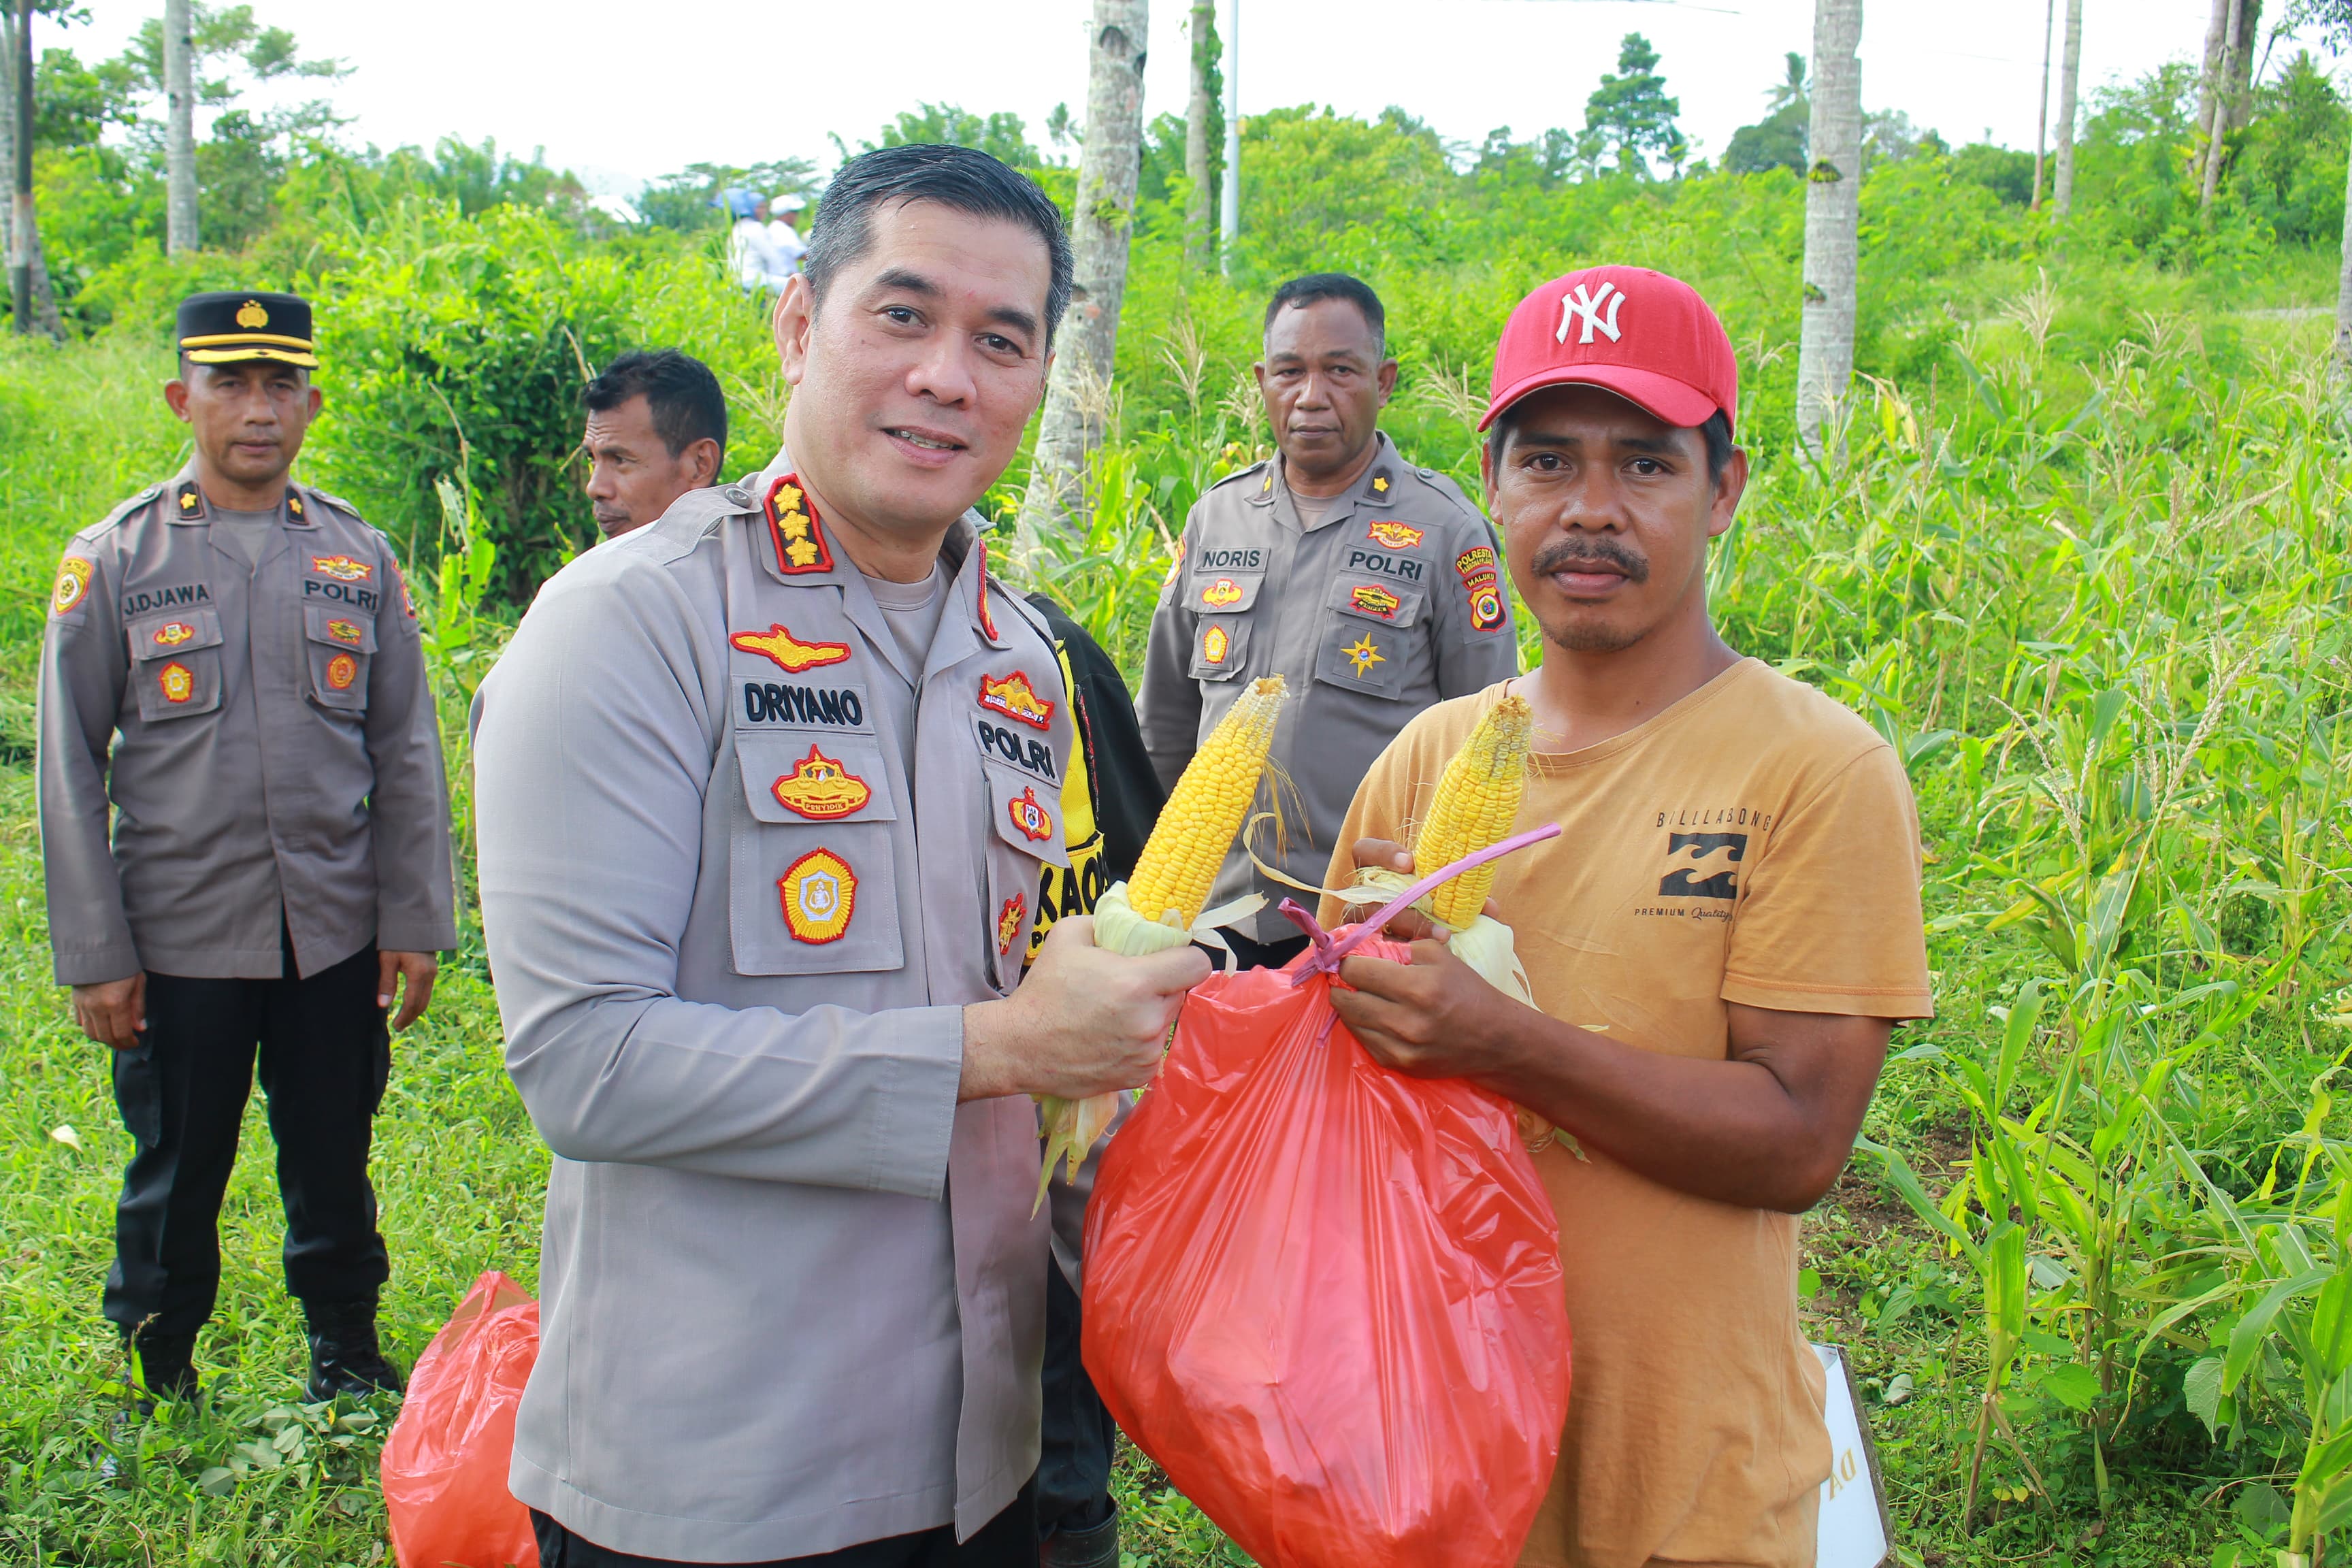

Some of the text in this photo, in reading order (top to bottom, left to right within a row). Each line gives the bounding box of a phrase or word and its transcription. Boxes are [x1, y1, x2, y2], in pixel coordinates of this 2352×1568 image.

[1556, 282, 1626, 344] NY
[1203, 550, 1260, 568] NORIS
[1349, 551, 1423, 581] POLRI
[304, 580, 378, 610] POLRI
[1467, 573, 1494, 587] MALUKU
[124, 584, 210, 615] J.DJAWA
[745, 683, 863, 726] DRIYANO
[978, 720, 1056, 779] POLRI
[1656, 808, 1771, 831] BILLABONG
[1634, 906, 1733, 922] PREMIUM Quality
